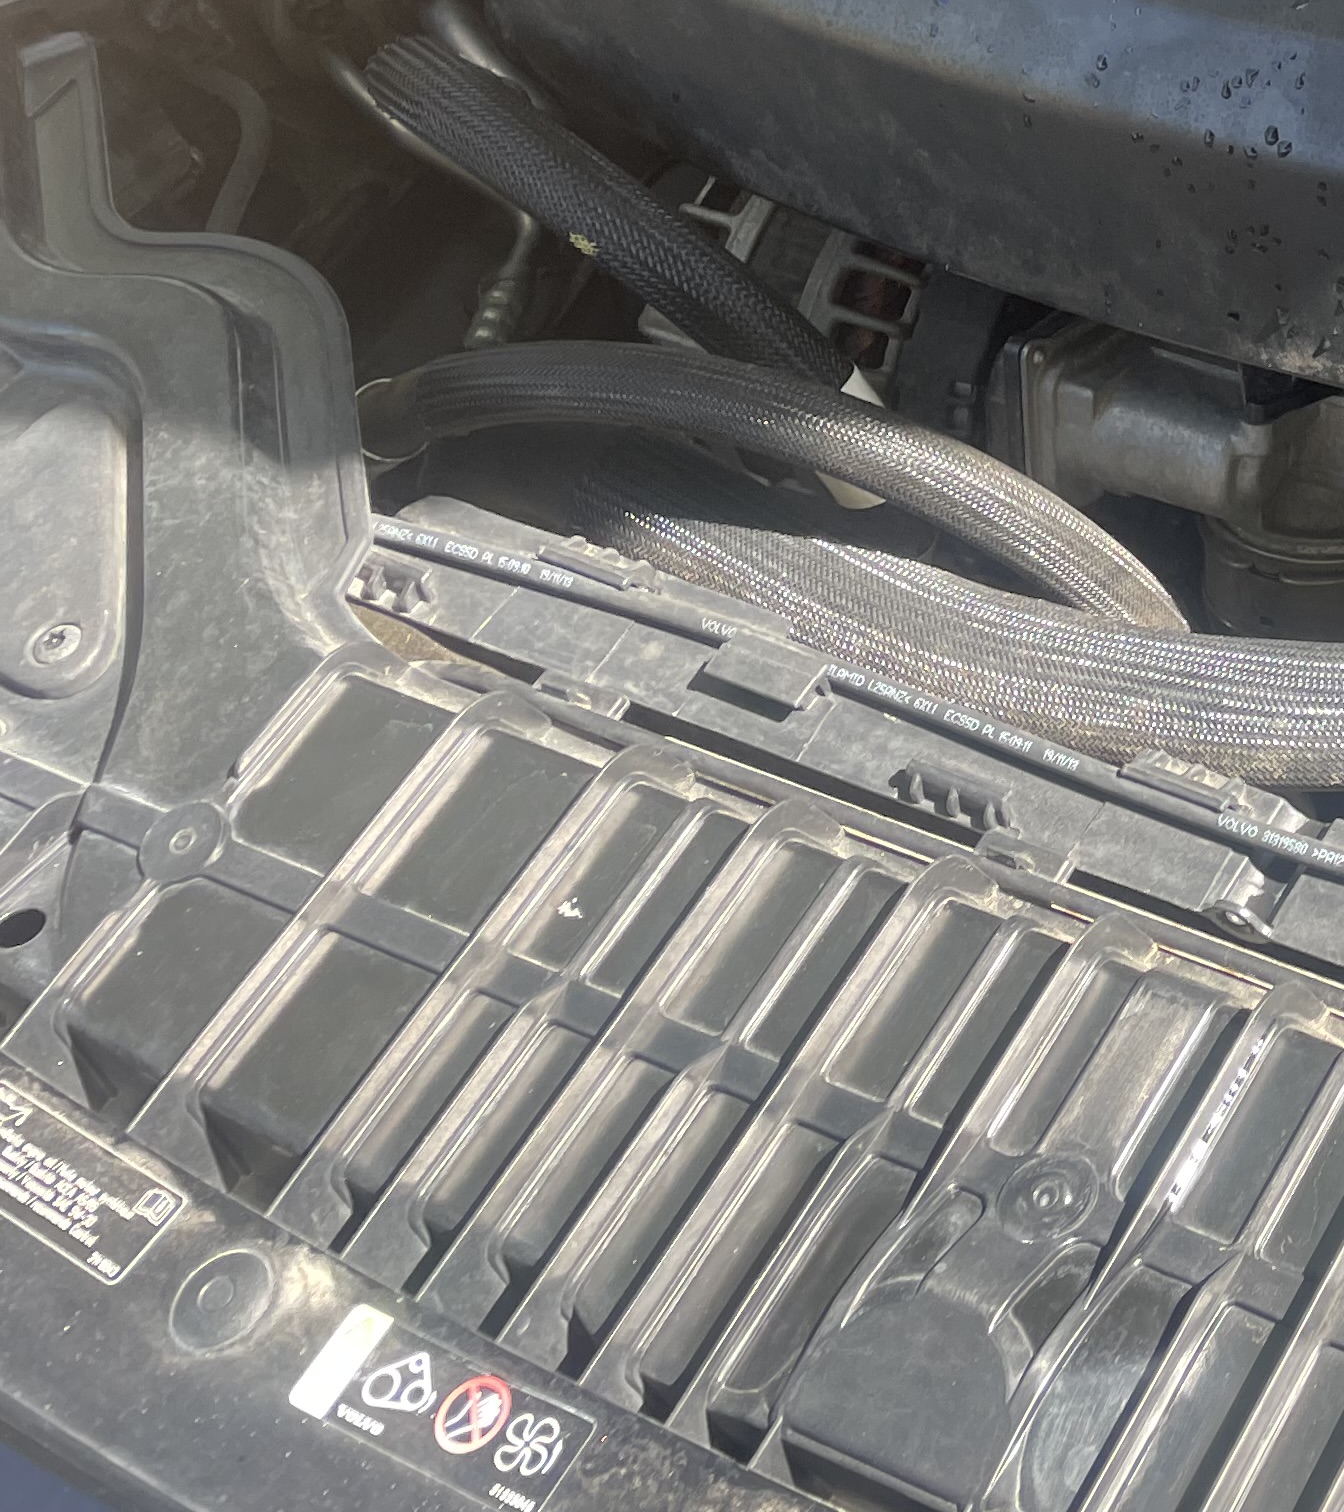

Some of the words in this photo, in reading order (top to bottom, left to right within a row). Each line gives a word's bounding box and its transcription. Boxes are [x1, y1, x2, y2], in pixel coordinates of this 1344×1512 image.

[481, 552, 493, 565] PL
[982, 724, 996, 739] PL
[1043, 748, 1080, 772] 19/11/13
[1217, 814, 1258, 838] VOLVO
